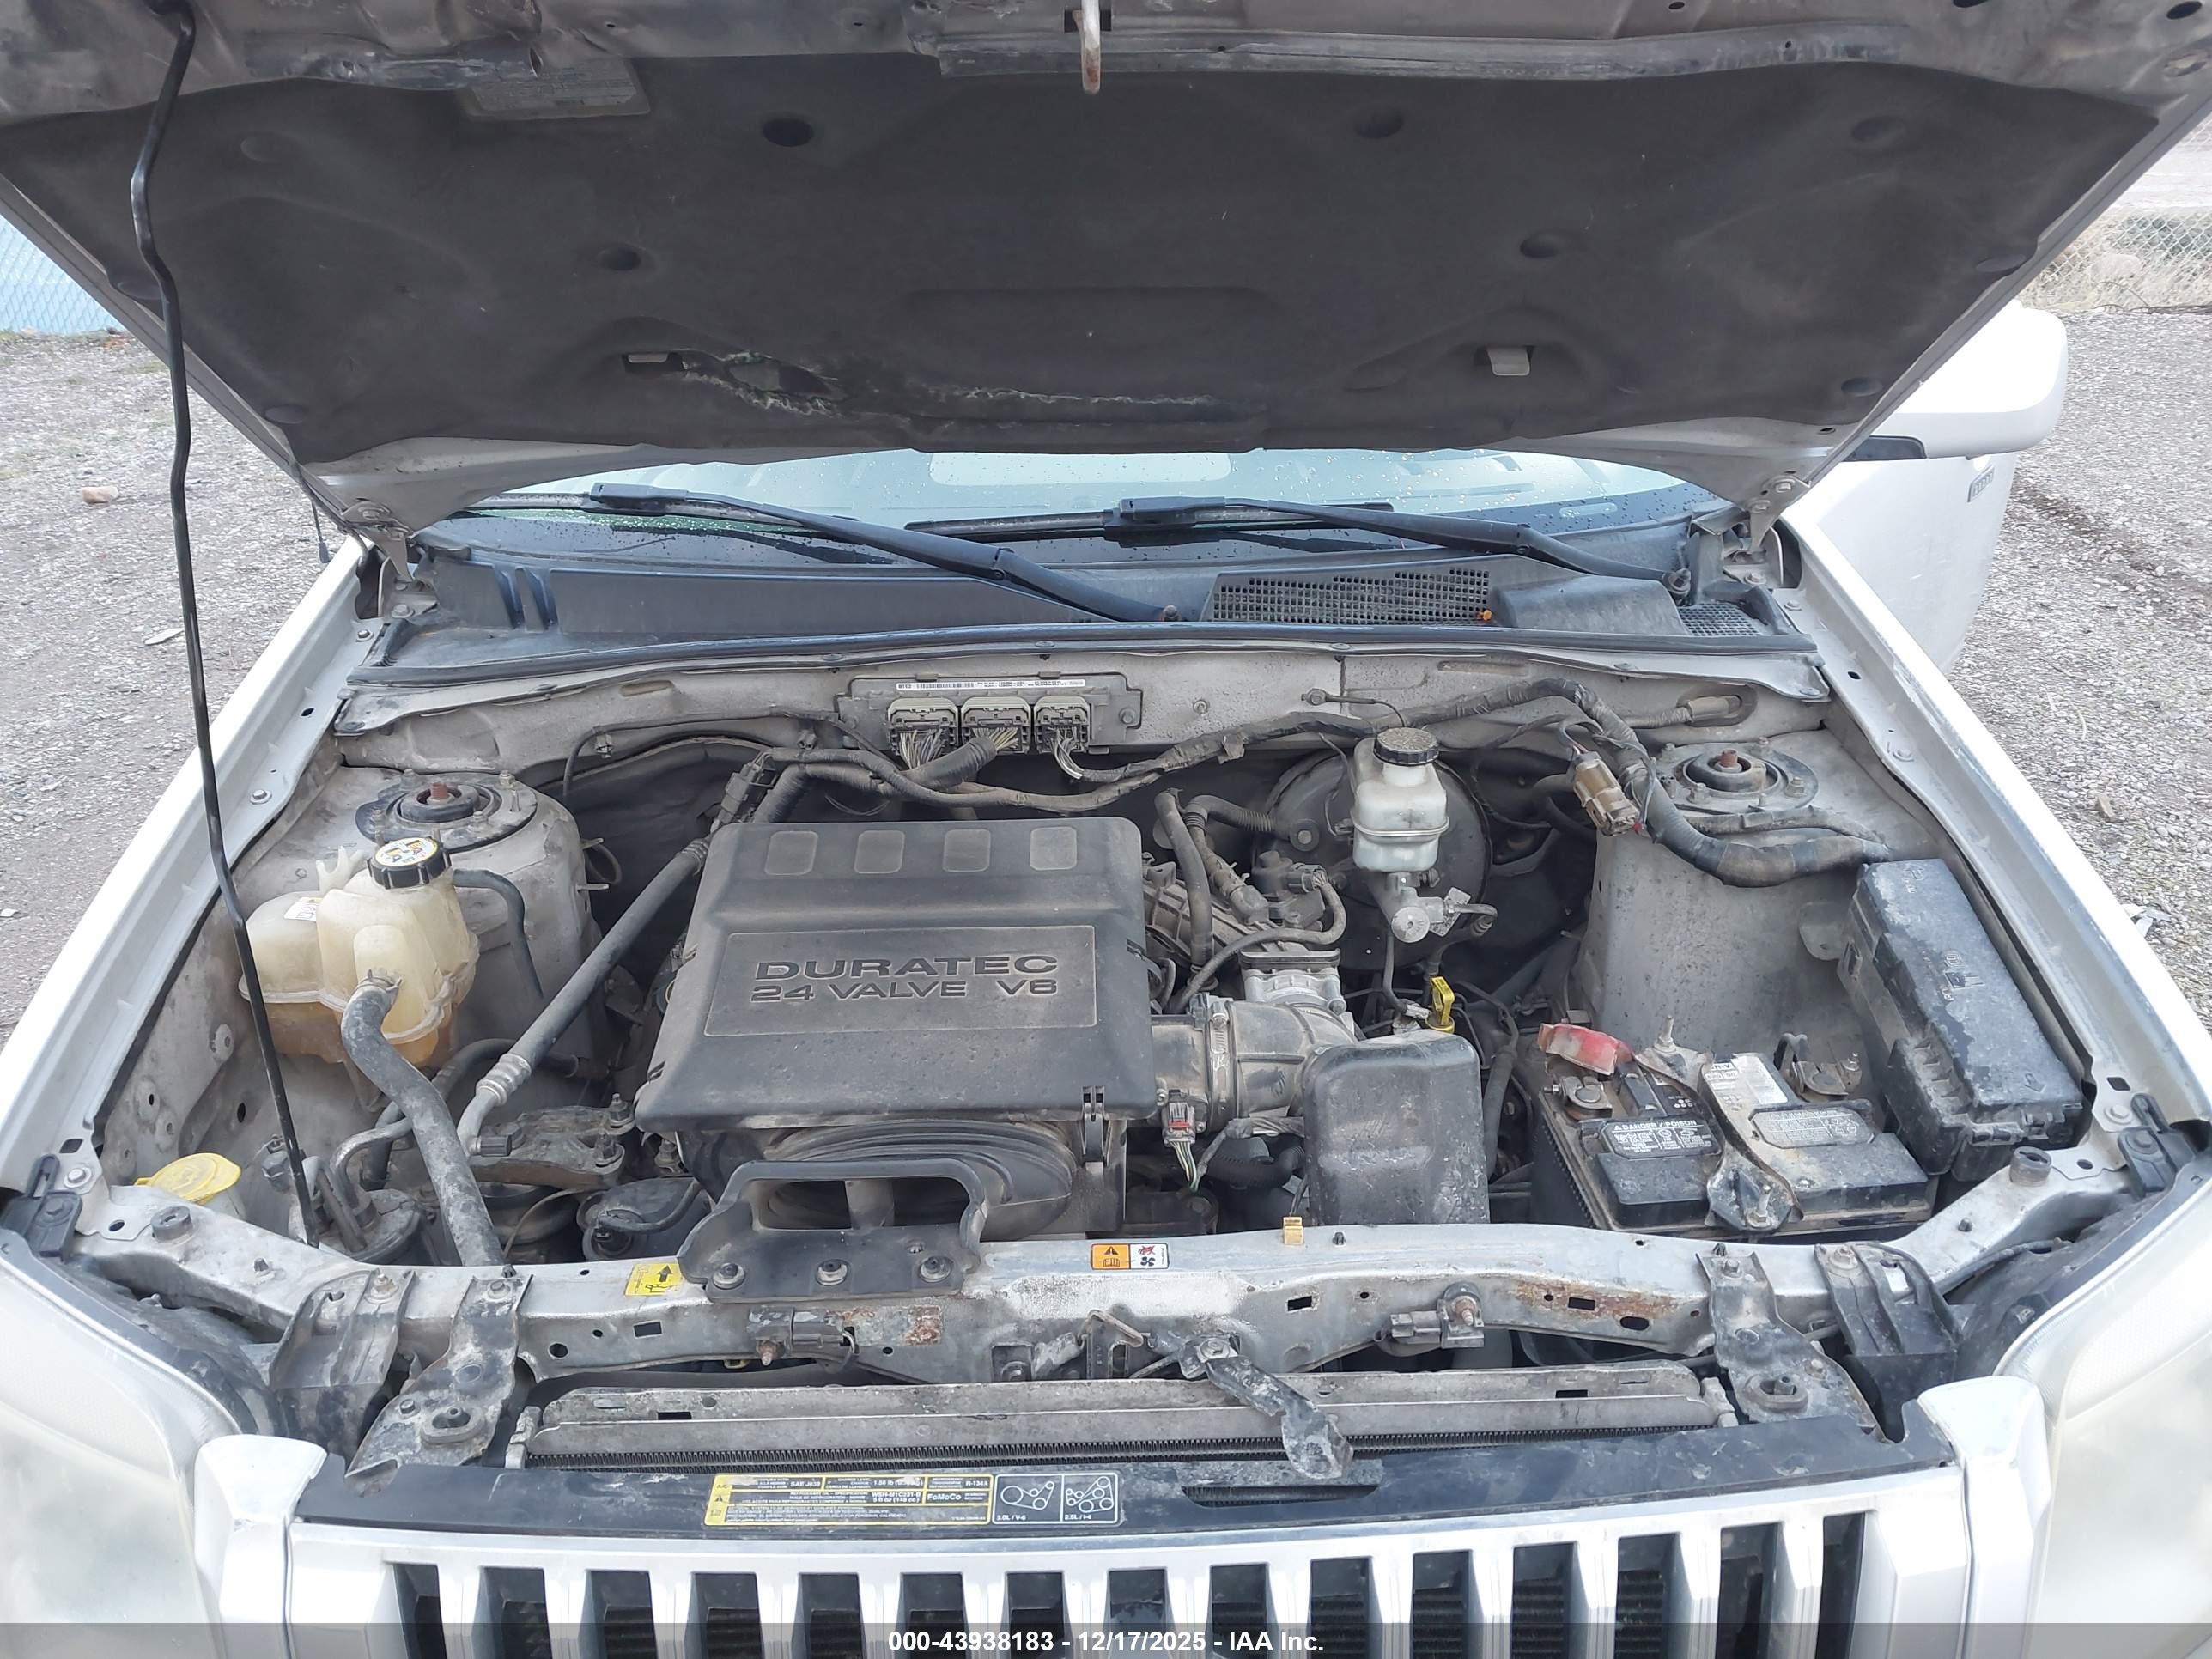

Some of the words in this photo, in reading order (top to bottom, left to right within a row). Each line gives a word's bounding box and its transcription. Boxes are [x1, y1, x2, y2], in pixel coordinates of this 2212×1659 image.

[755, 955, 1059, 981] DURATEC
[750, 984, 815, 1002] 24
[829, 981, 967, 1000] VALVE
